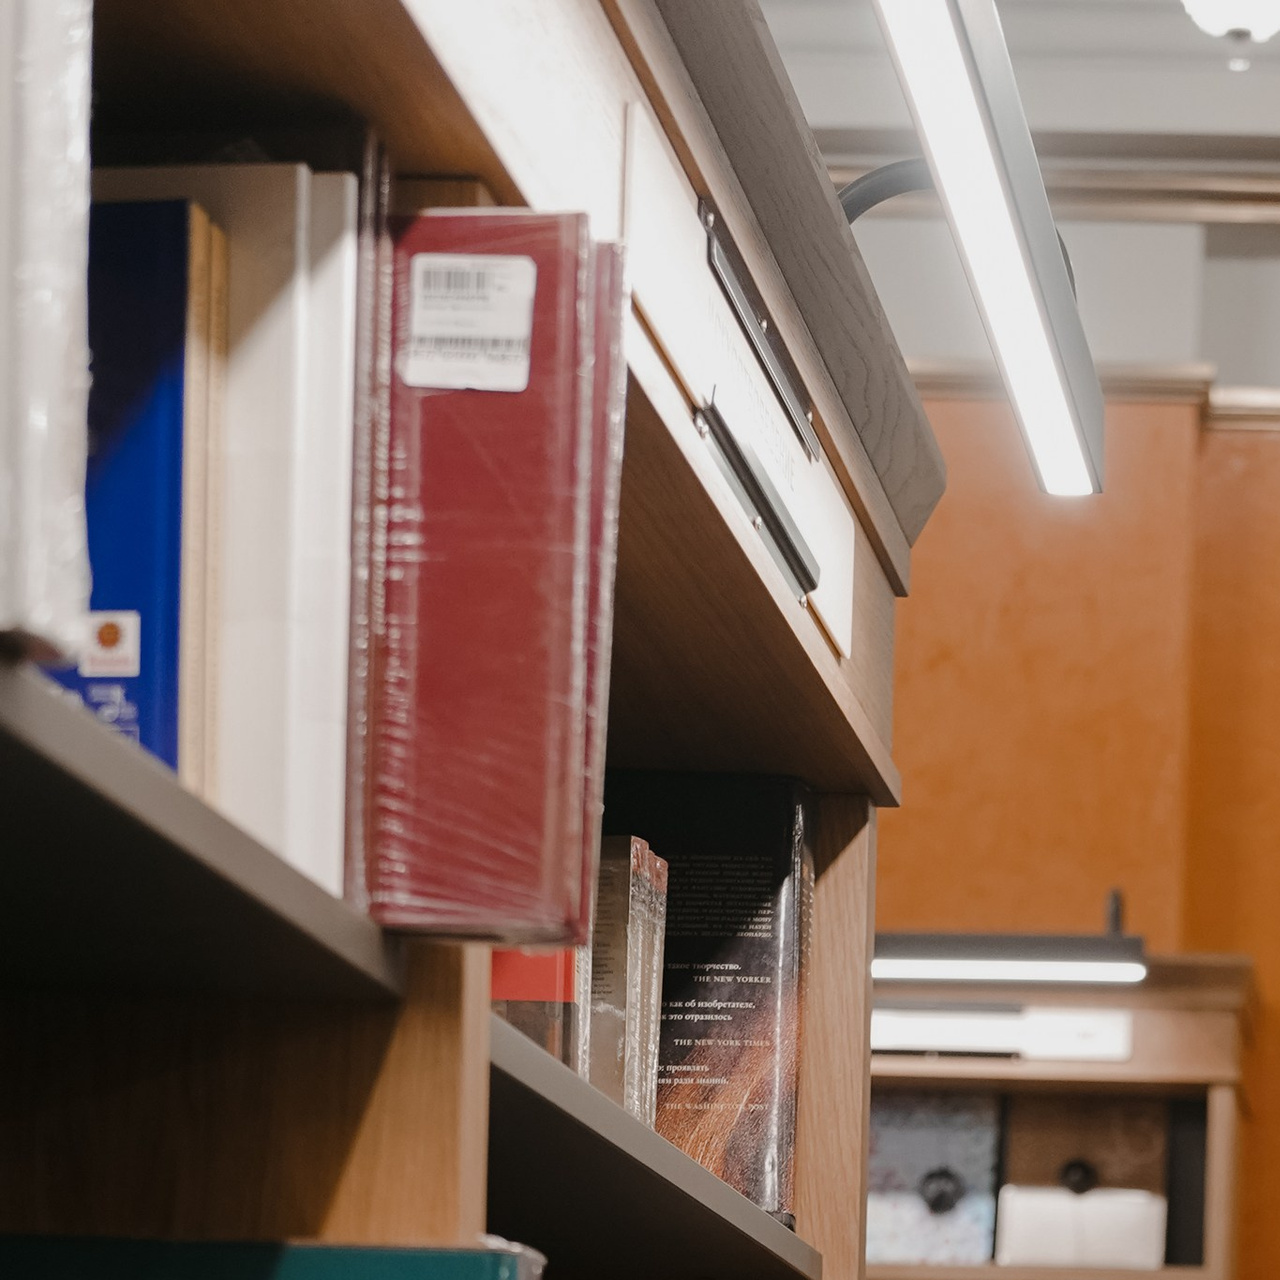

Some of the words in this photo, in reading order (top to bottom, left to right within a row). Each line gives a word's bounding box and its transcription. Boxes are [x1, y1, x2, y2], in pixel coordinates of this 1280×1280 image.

[693, 962, 741, 972] творчество.
[693, 975, 711, 983] THE
[713, 975, 734, 983] NEW
[736, 975, 772, 984] YORKER
[684, 999, 696, 1008] об
[698, 1000, 756, 1010] изобретателе,
[685, 1014, 733, 1022] отразилось
[673, 1038, 693, 1046] THE
[695, 1038, 714, 1046] NEW
[716, 1039, 741, 1047] YORK
[744, 1039, 771, 1047] TIMES
[666, 1064, 710, 1073] проявлять
[684, 1102, 744, 1110] WASHINGTON
